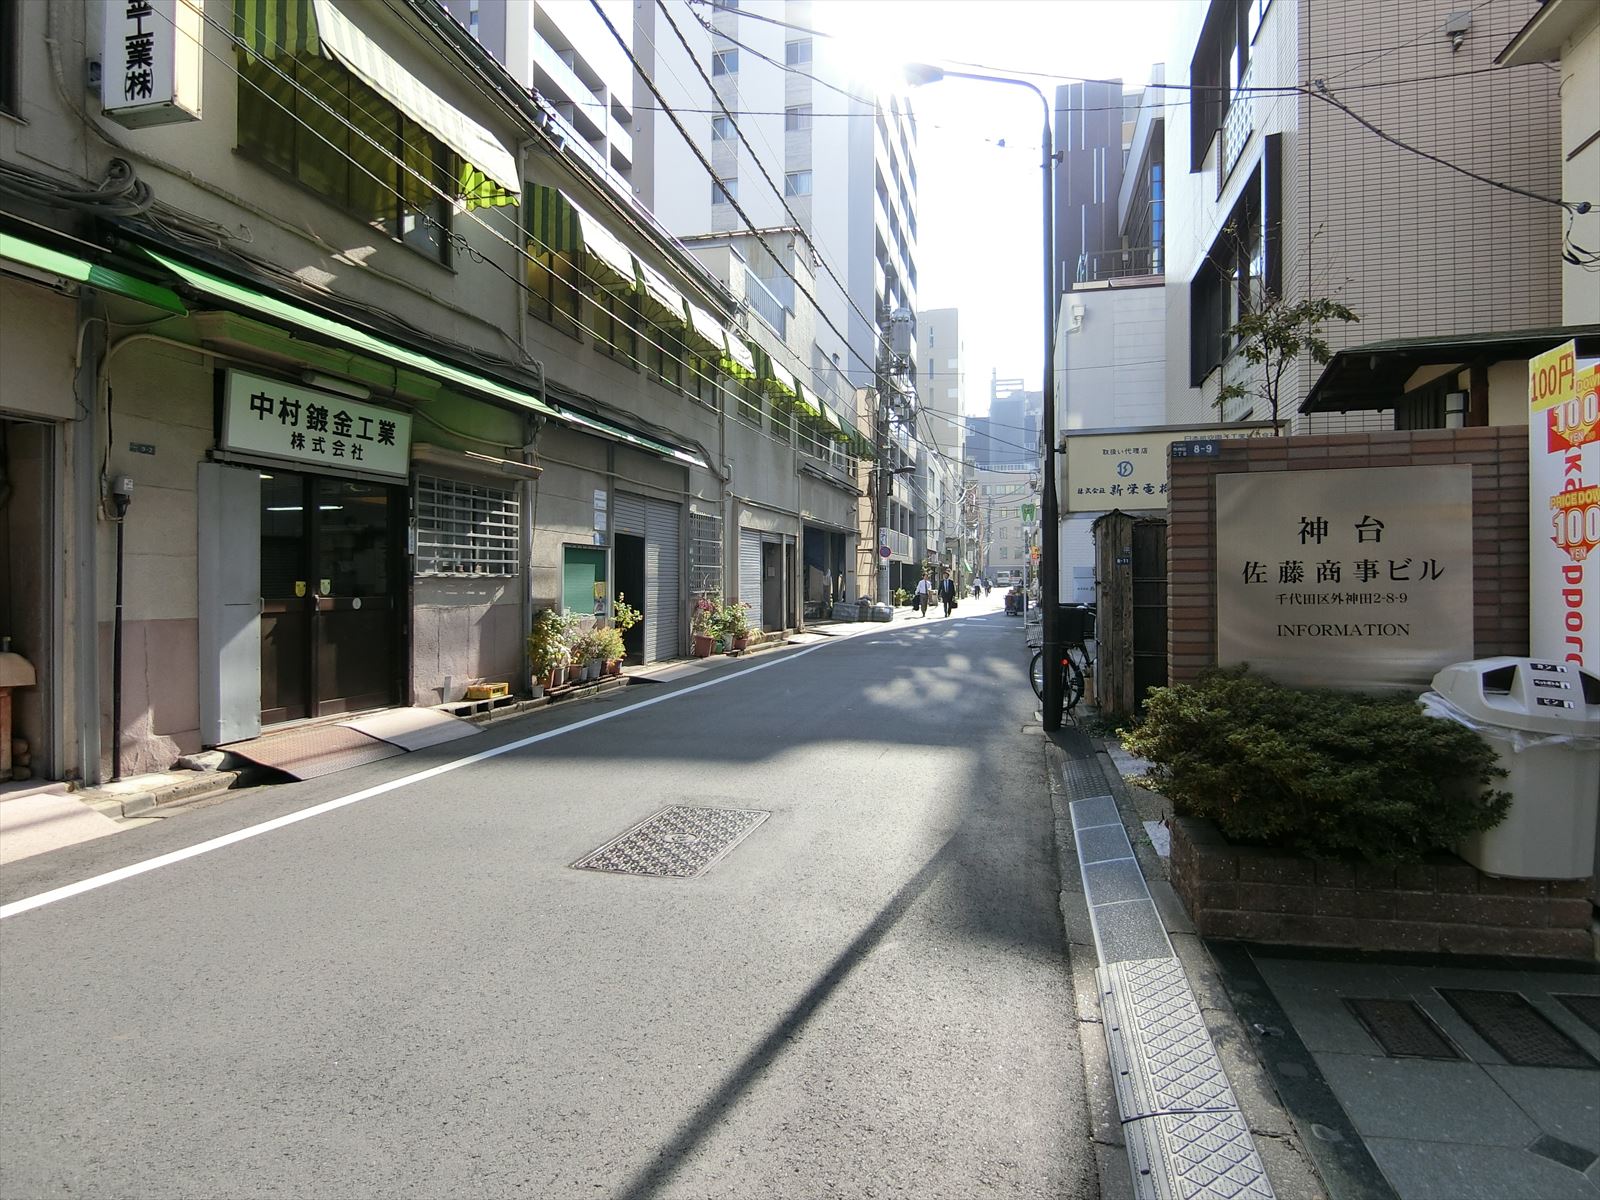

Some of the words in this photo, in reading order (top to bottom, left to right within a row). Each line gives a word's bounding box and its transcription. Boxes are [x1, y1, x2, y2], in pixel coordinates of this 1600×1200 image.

[1531, 352, 1574, 402] 100円
[250, 392, 396, 446] 中村鍍金工業
[1553, 391, 1598, 433] 100
[290, 431, 363, 461] 株式会社
[1193, 444, 1213, 454] 8-9
[1552, 504, 1600, 548] 100
[1241, 557, 1446, 585] 佐藤商事ビル
[1275, 592, 1408, 605] 千代田区外神田2-8-9
[1276, 623, 1410, 637] INFORMATION
